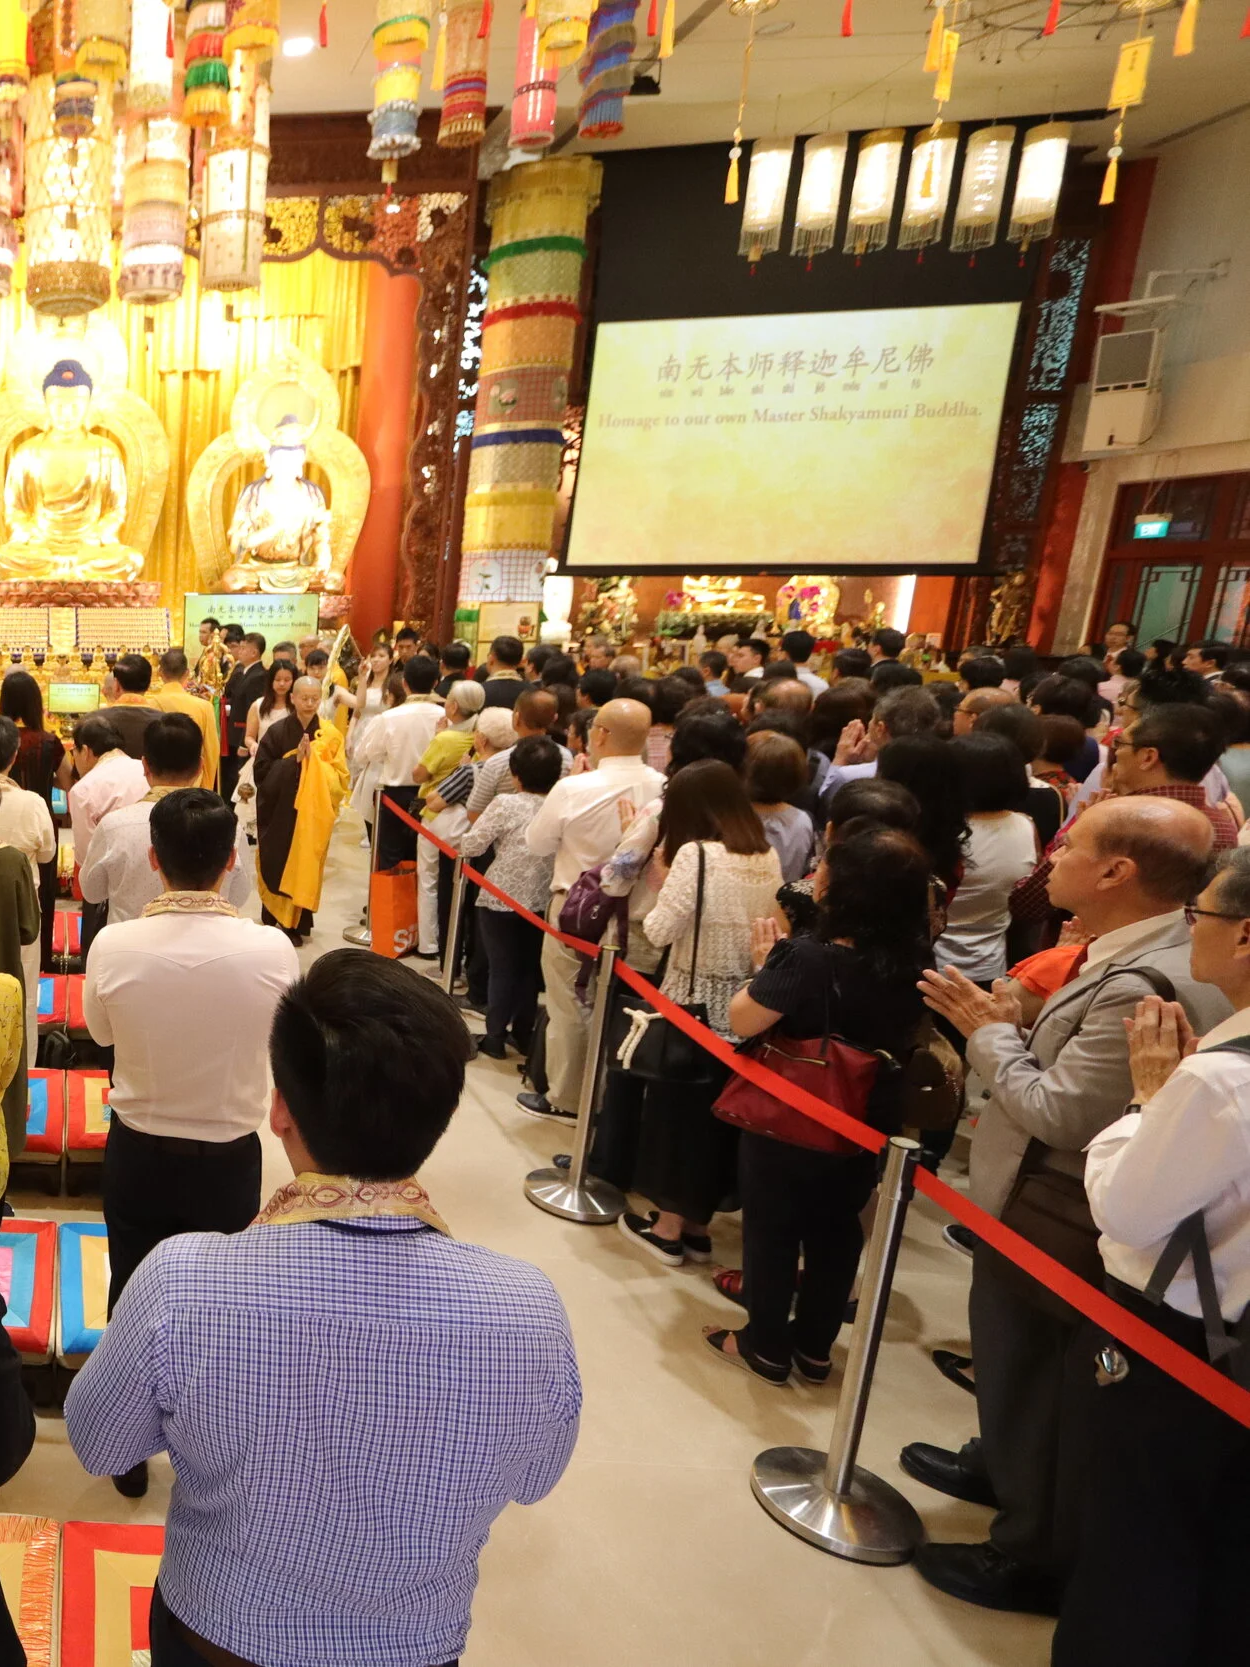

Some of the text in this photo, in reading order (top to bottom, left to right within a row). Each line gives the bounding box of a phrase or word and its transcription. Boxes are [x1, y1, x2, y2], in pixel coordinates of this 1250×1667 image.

[657, 343, 935, 383] 南无本师释迦牟尼佛
[597, 400, 983, 431] Homage to our own Master Shakyamuni Buddha.
